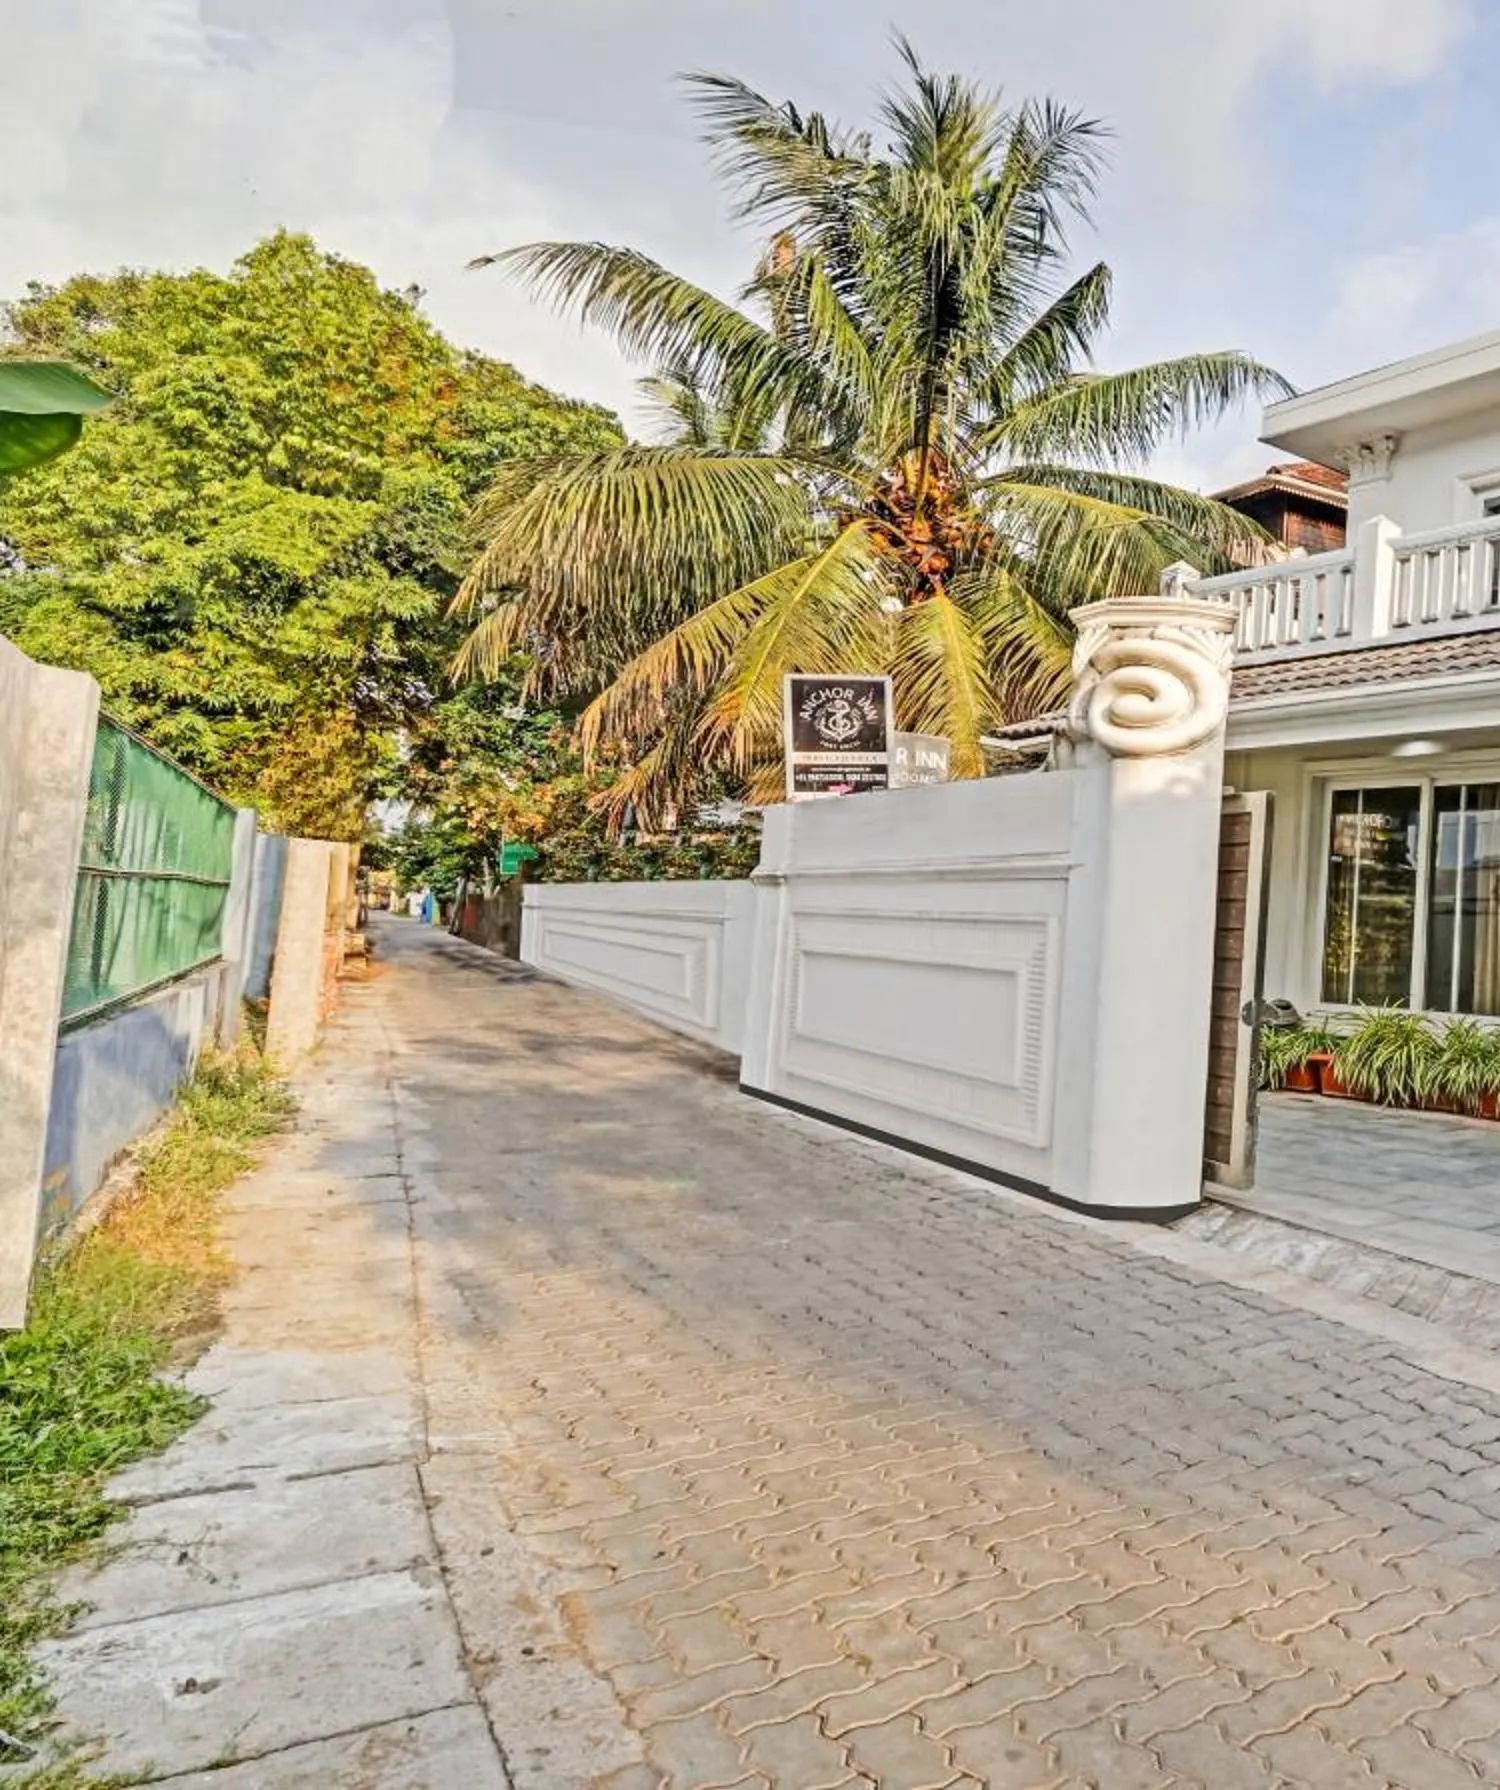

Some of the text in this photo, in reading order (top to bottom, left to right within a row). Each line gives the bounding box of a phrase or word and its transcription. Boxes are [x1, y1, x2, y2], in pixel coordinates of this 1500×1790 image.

[800, 687, 879, 720] ANCHOR INN
[915, 751, 947, 770] INN
